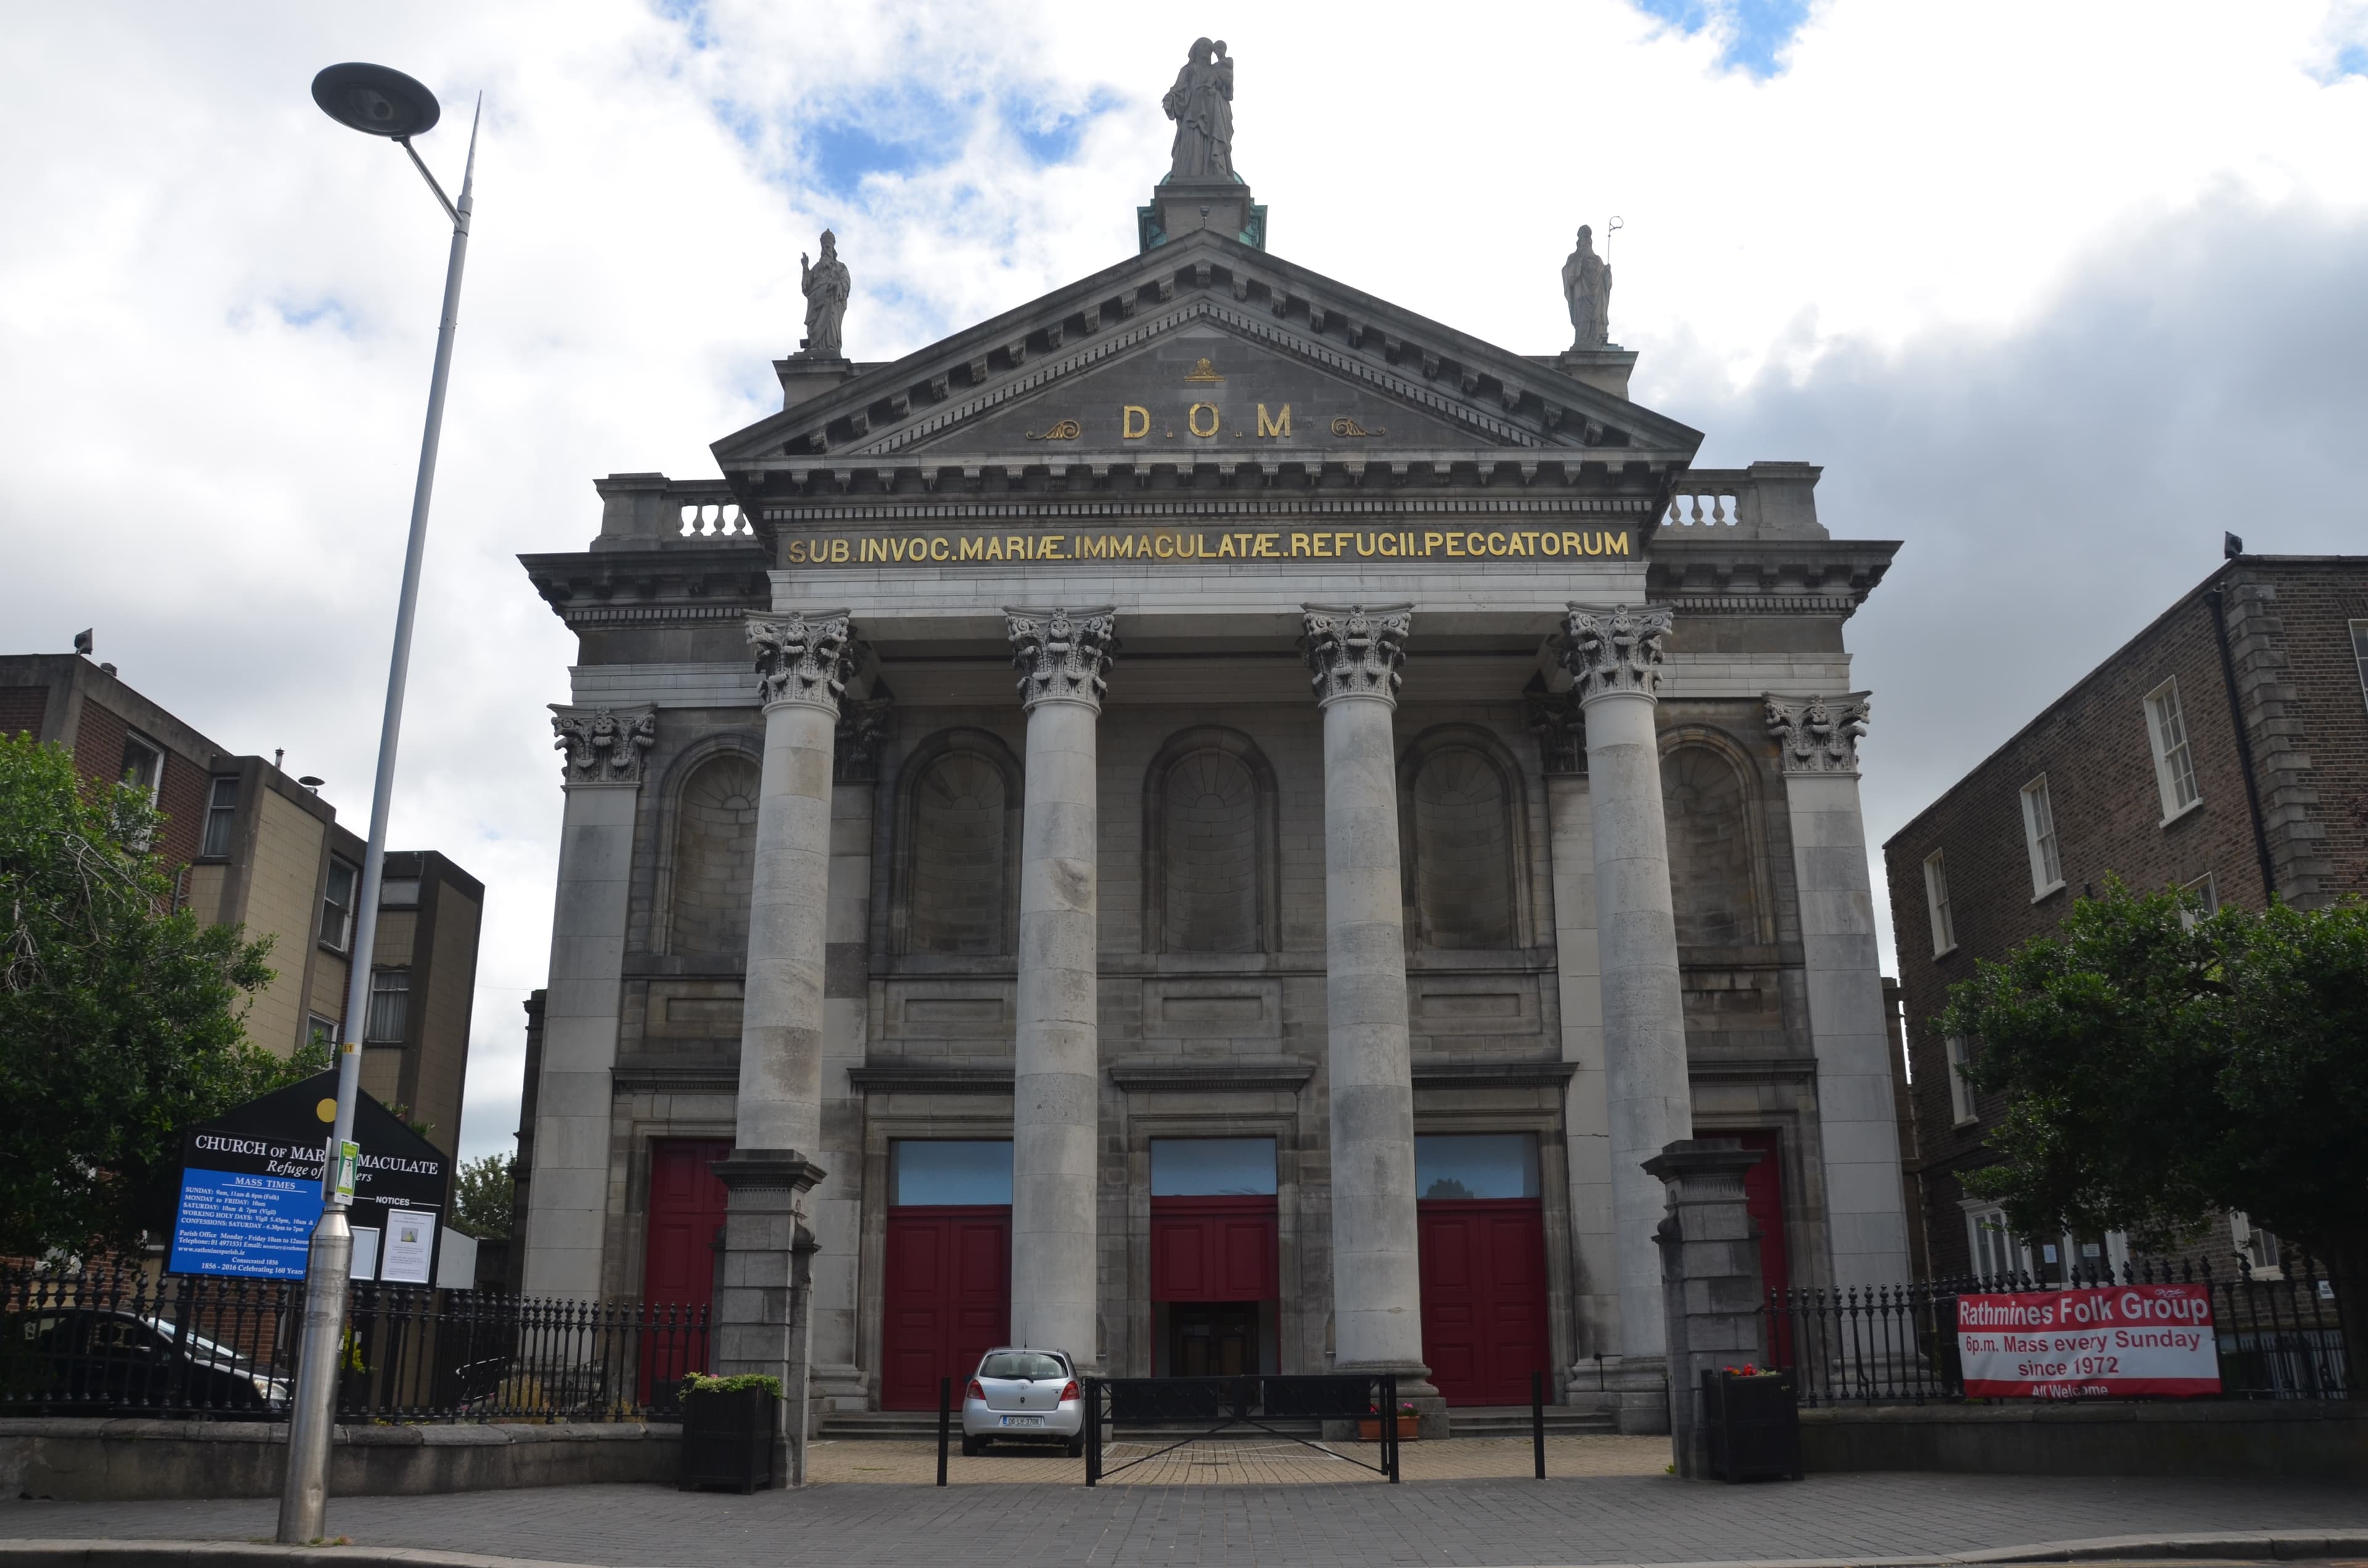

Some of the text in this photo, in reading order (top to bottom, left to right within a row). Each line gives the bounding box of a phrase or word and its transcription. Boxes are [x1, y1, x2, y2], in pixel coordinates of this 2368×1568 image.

[195, 1135, 268, 1155] CHURCH
[270, 1147, 287, 1158] OF
[290, 1146, 326, 1162] MAR
[357, 1154, 438, 1175] MACULATE
[266, 1160, 324, 1180] Refuge of
[235, 1177, 296, 1189] MASS TIMES
[183, 1202, 219, 1210] SATURDAY:
[224, 1197, 250, 1205] FRIDAY:
[376, 1196, 410, 1206] NOTICES
[183, 1209, 215, 1217] WORKING
[181, 1217, 227, 1226] CONFESSIONS:
[228, 1221, 262, 1229] SATURDAY
[178, 1237, 210, 1245] Telephone:
[220, 1233, 244, 1241] Monday
[248, 1234, 266, 1242] Friday
[178, 1246, 245, 1255] www.rathminesparish.ie
[237, 1265, 274, 1274] Celebrating
[1960, 1292, 2208, 1325] Rathmines Folk Group
[1966, 1329, 2200, 1355] 6p.m. Mass every Sunday
[2018, 1356, 2119, 1376] since 1972
[2033, 1384, 2108, 1398] All Welcome
